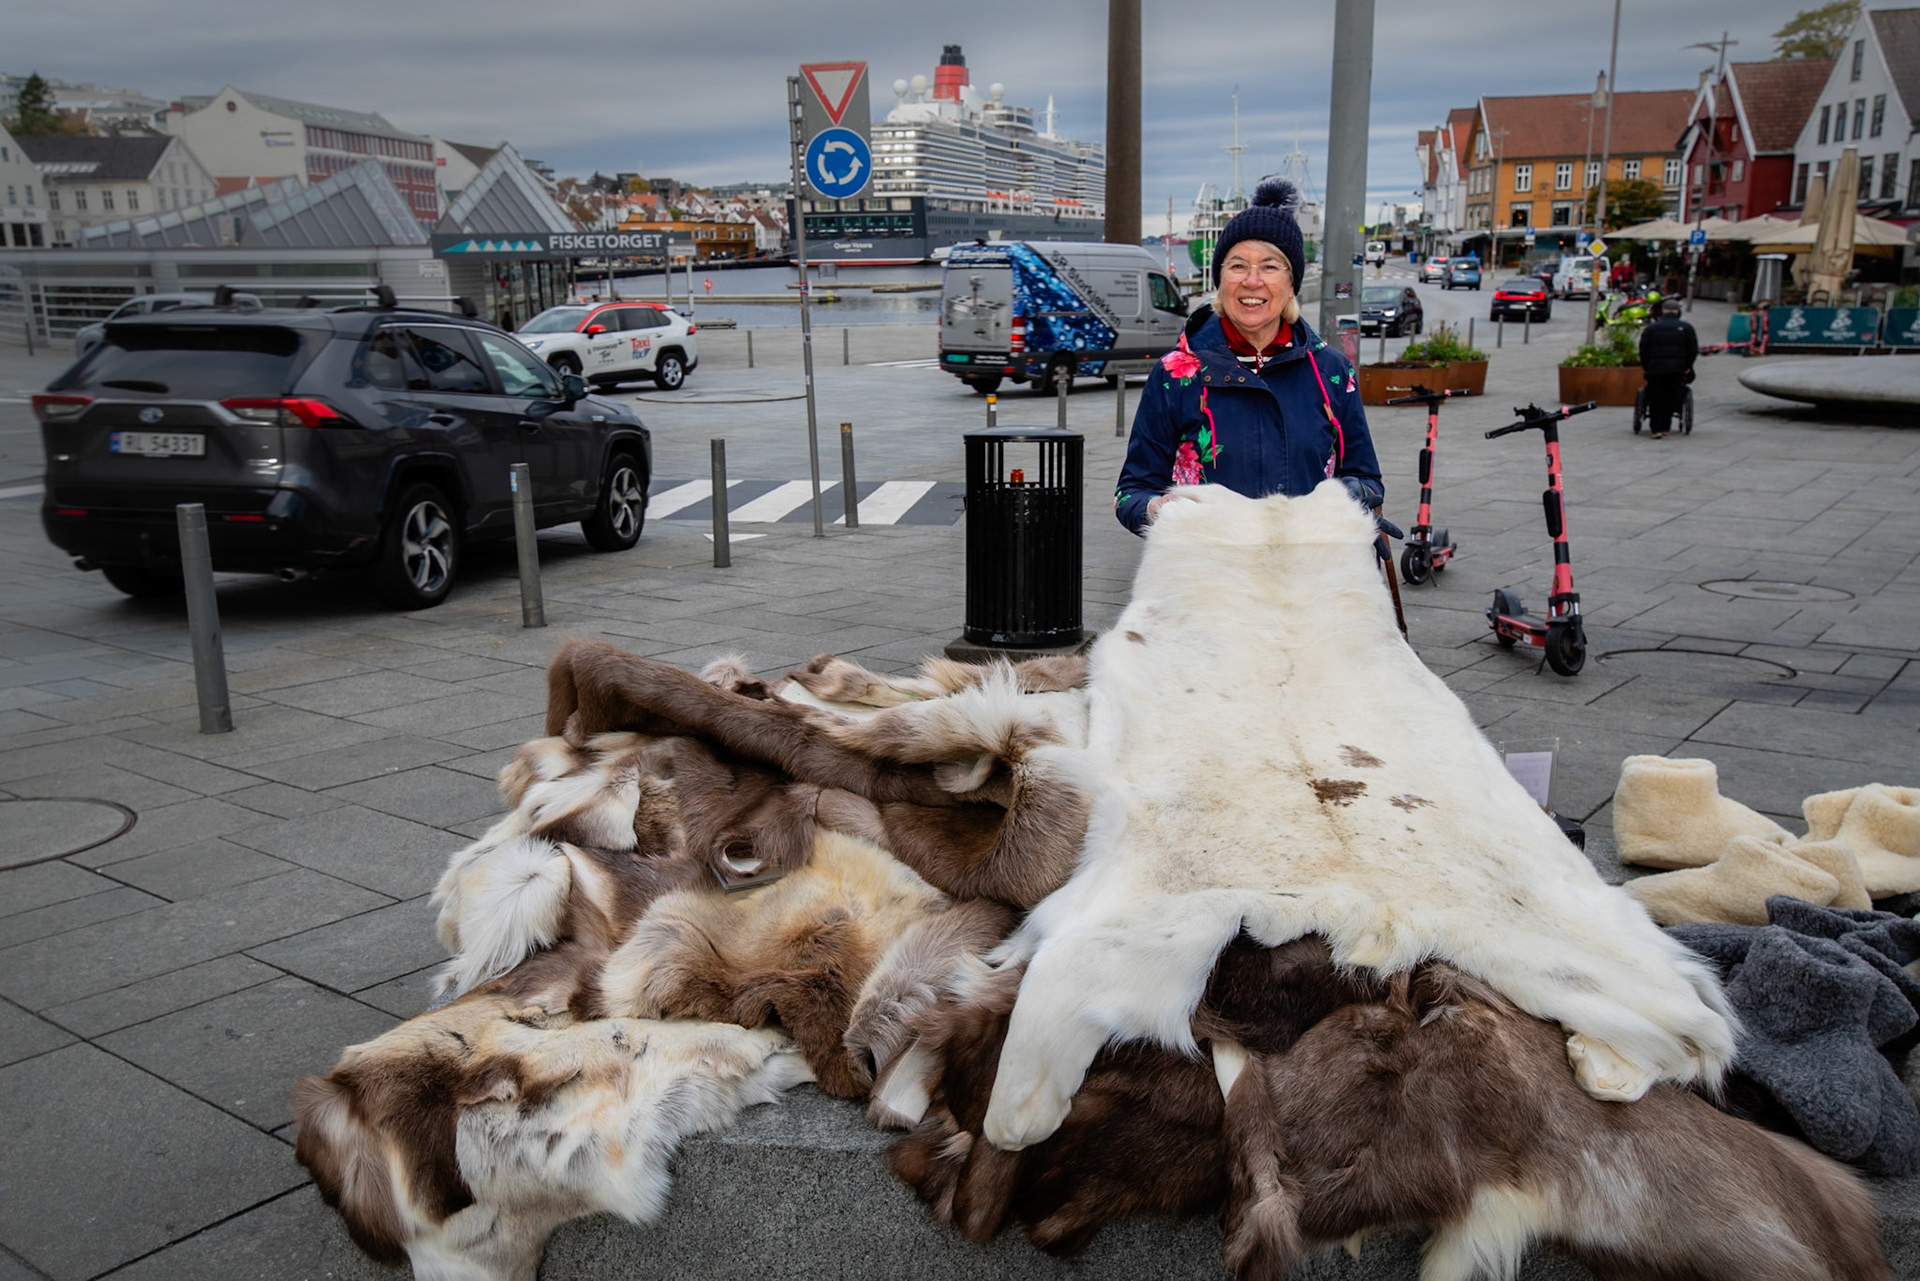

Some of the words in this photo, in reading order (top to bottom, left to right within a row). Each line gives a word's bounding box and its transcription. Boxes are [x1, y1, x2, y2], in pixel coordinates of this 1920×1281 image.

[549, 234, 662, 249] FISKETORGET
[833, 242, 851, 250] Queen
[630, 336, 650, 350] Taxi
[125, 435, 142, 451] RL
[152, 436, 198, 452] 54331
